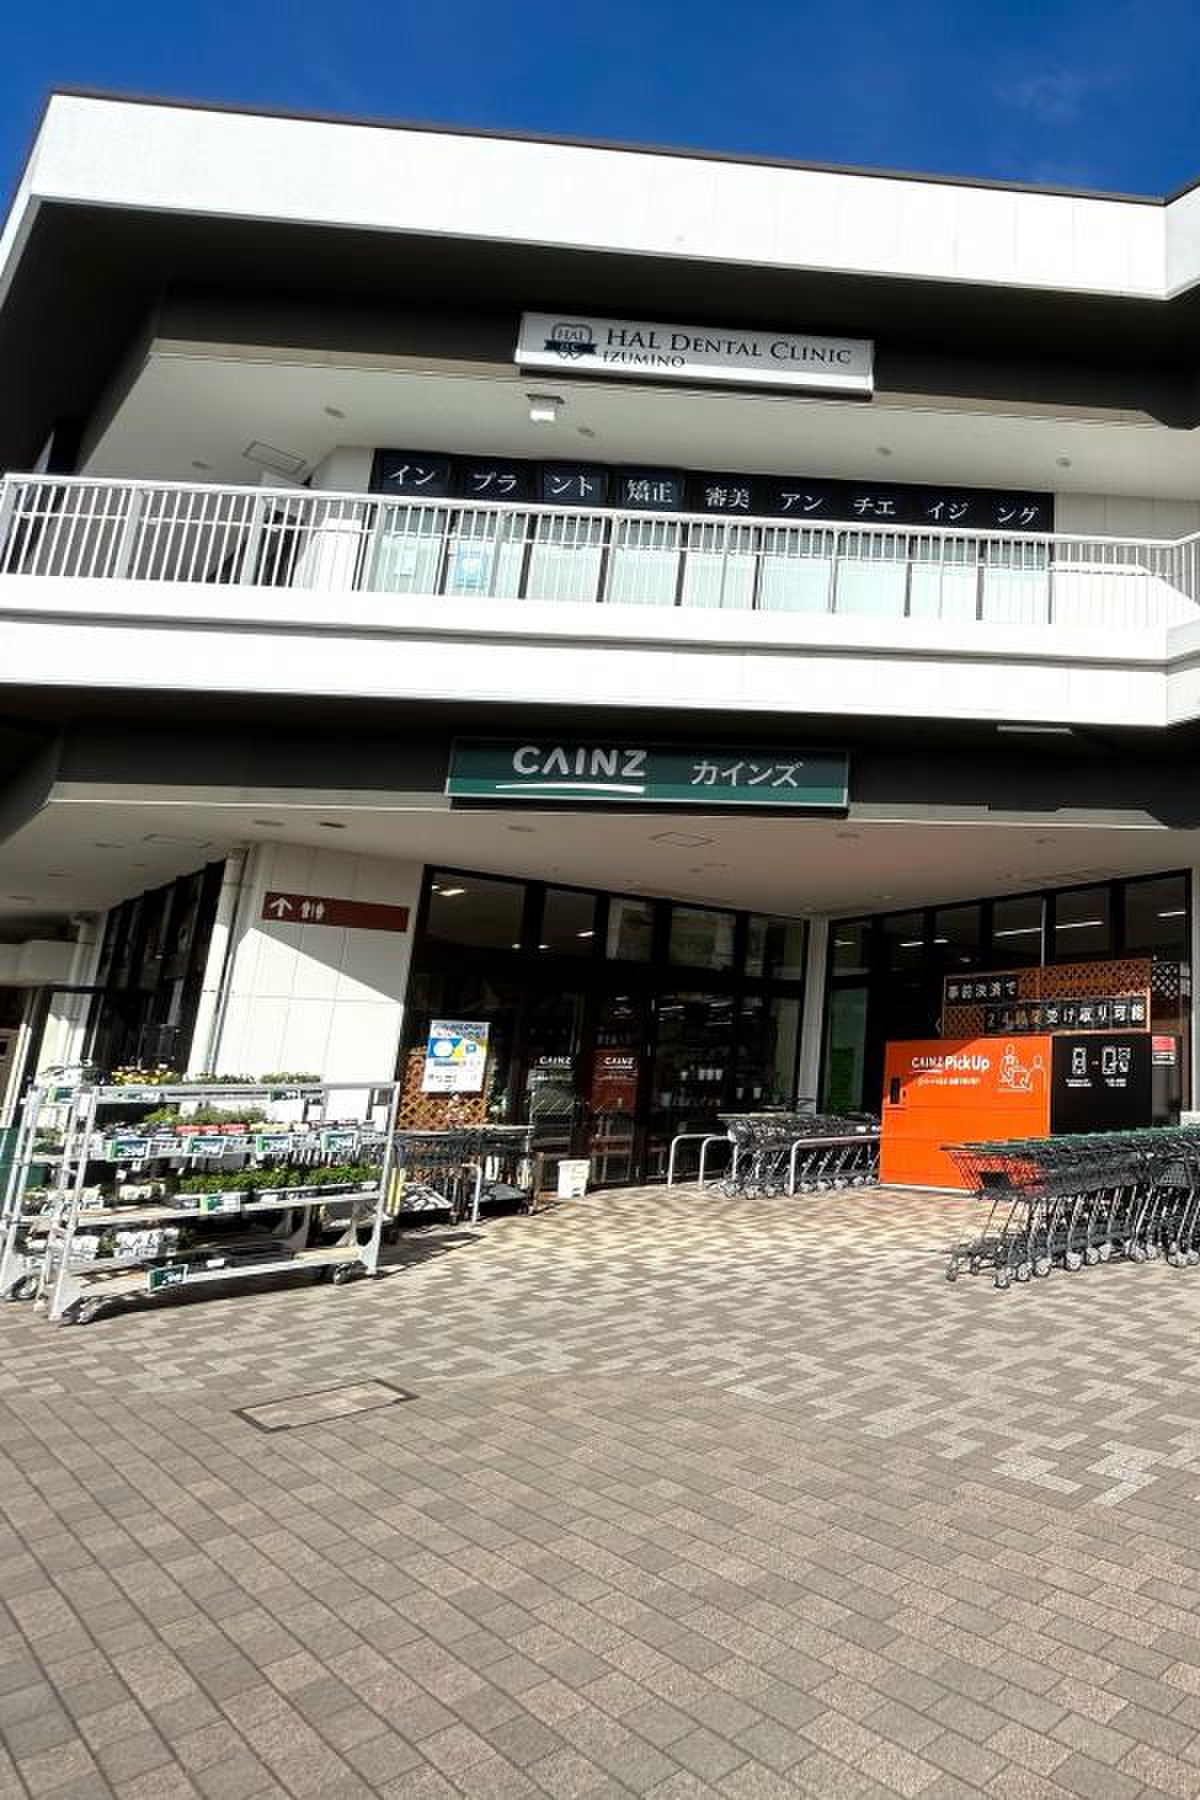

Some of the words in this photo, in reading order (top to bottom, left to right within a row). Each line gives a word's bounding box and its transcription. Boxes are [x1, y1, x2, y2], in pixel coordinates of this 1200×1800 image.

[603, 351, 686, 368] IZUMINO
[607, 328, 661, 351] HAL
[671, 333, 763, 358] DENTAL
[771, 341, 853, 364] CLINIC
[626, 480, 673, 504] 矯正
[704, 487, 750, 511] 審美
[512, 745, 648, 778] CAINZ
[692, 760, 804, 788] カインズ
[944, 1055, 991, 1071] PickUp
